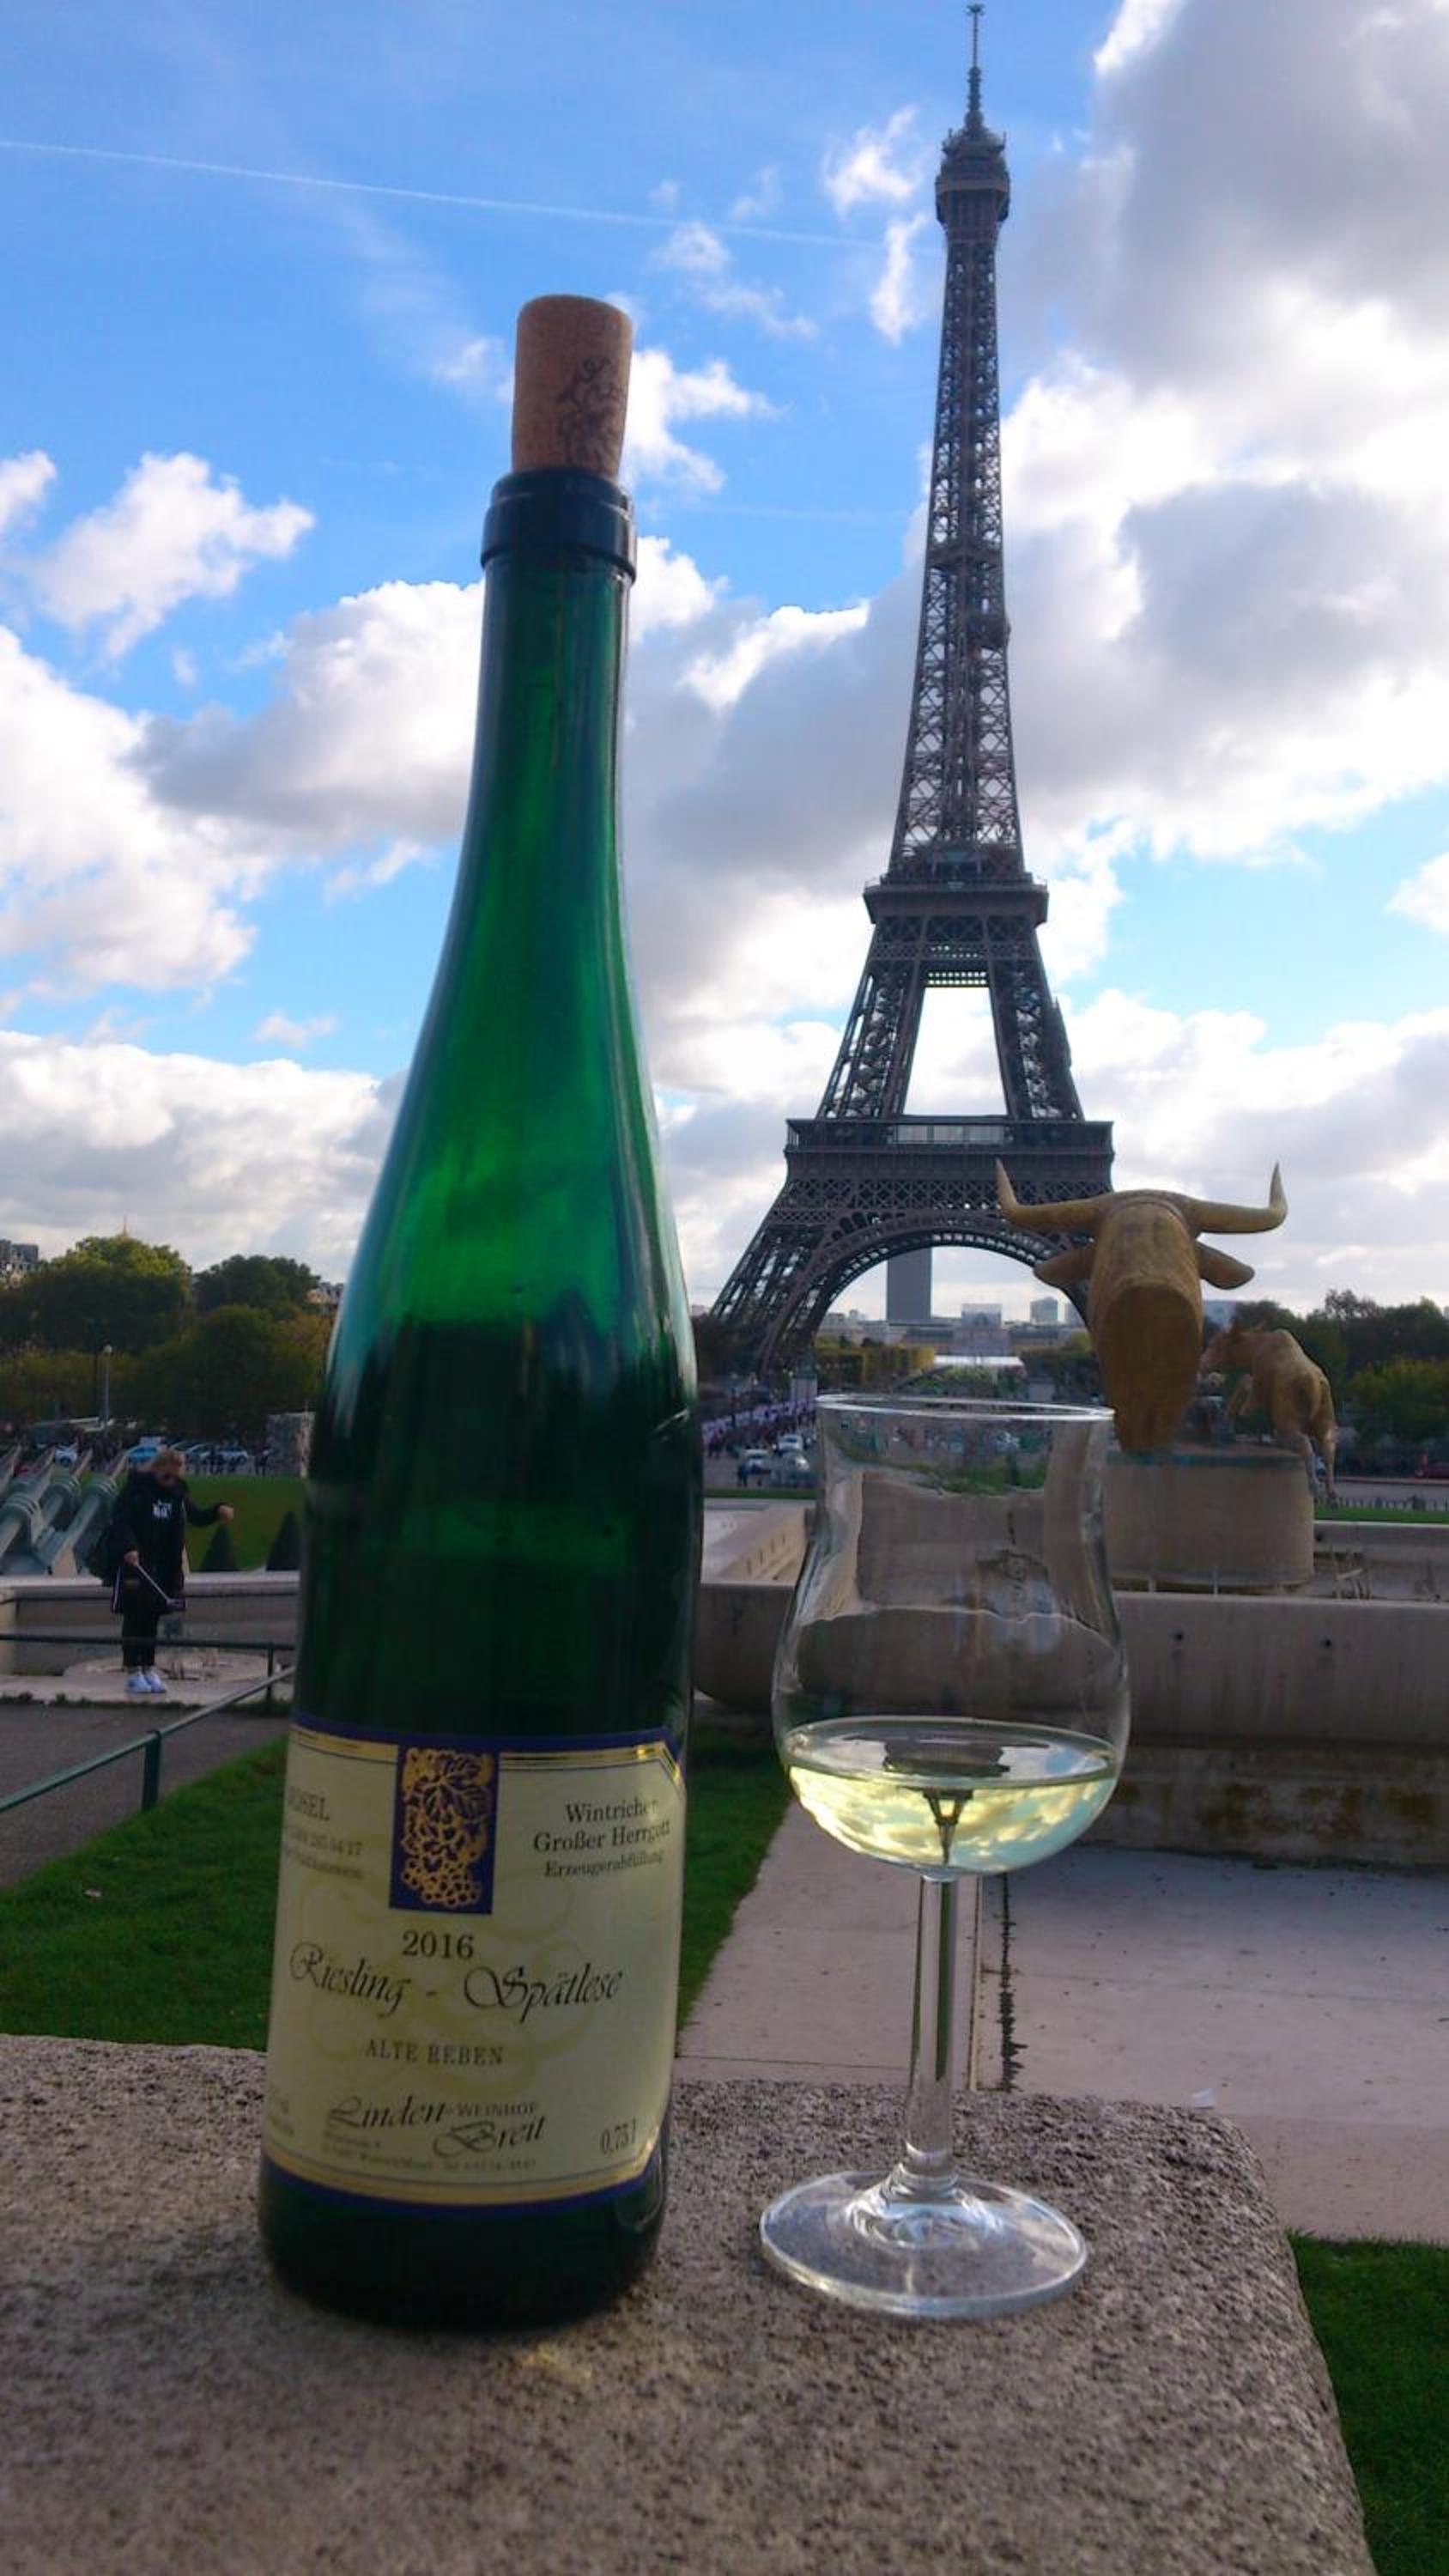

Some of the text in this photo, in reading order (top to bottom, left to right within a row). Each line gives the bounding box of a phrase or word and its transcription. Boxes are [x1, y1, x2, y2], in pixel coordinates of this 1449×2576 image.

[533, 1829, 606, 1853] Großer
[402, 1929, 475, 1960] 2016
[289, 1941, 412, 2019] Riesling
[464, 1961, 624, 2023] Spätlese
[366, 2038, 505, 2068] ALTE REBEN
[326, 2094, 446, 2130] Linden
